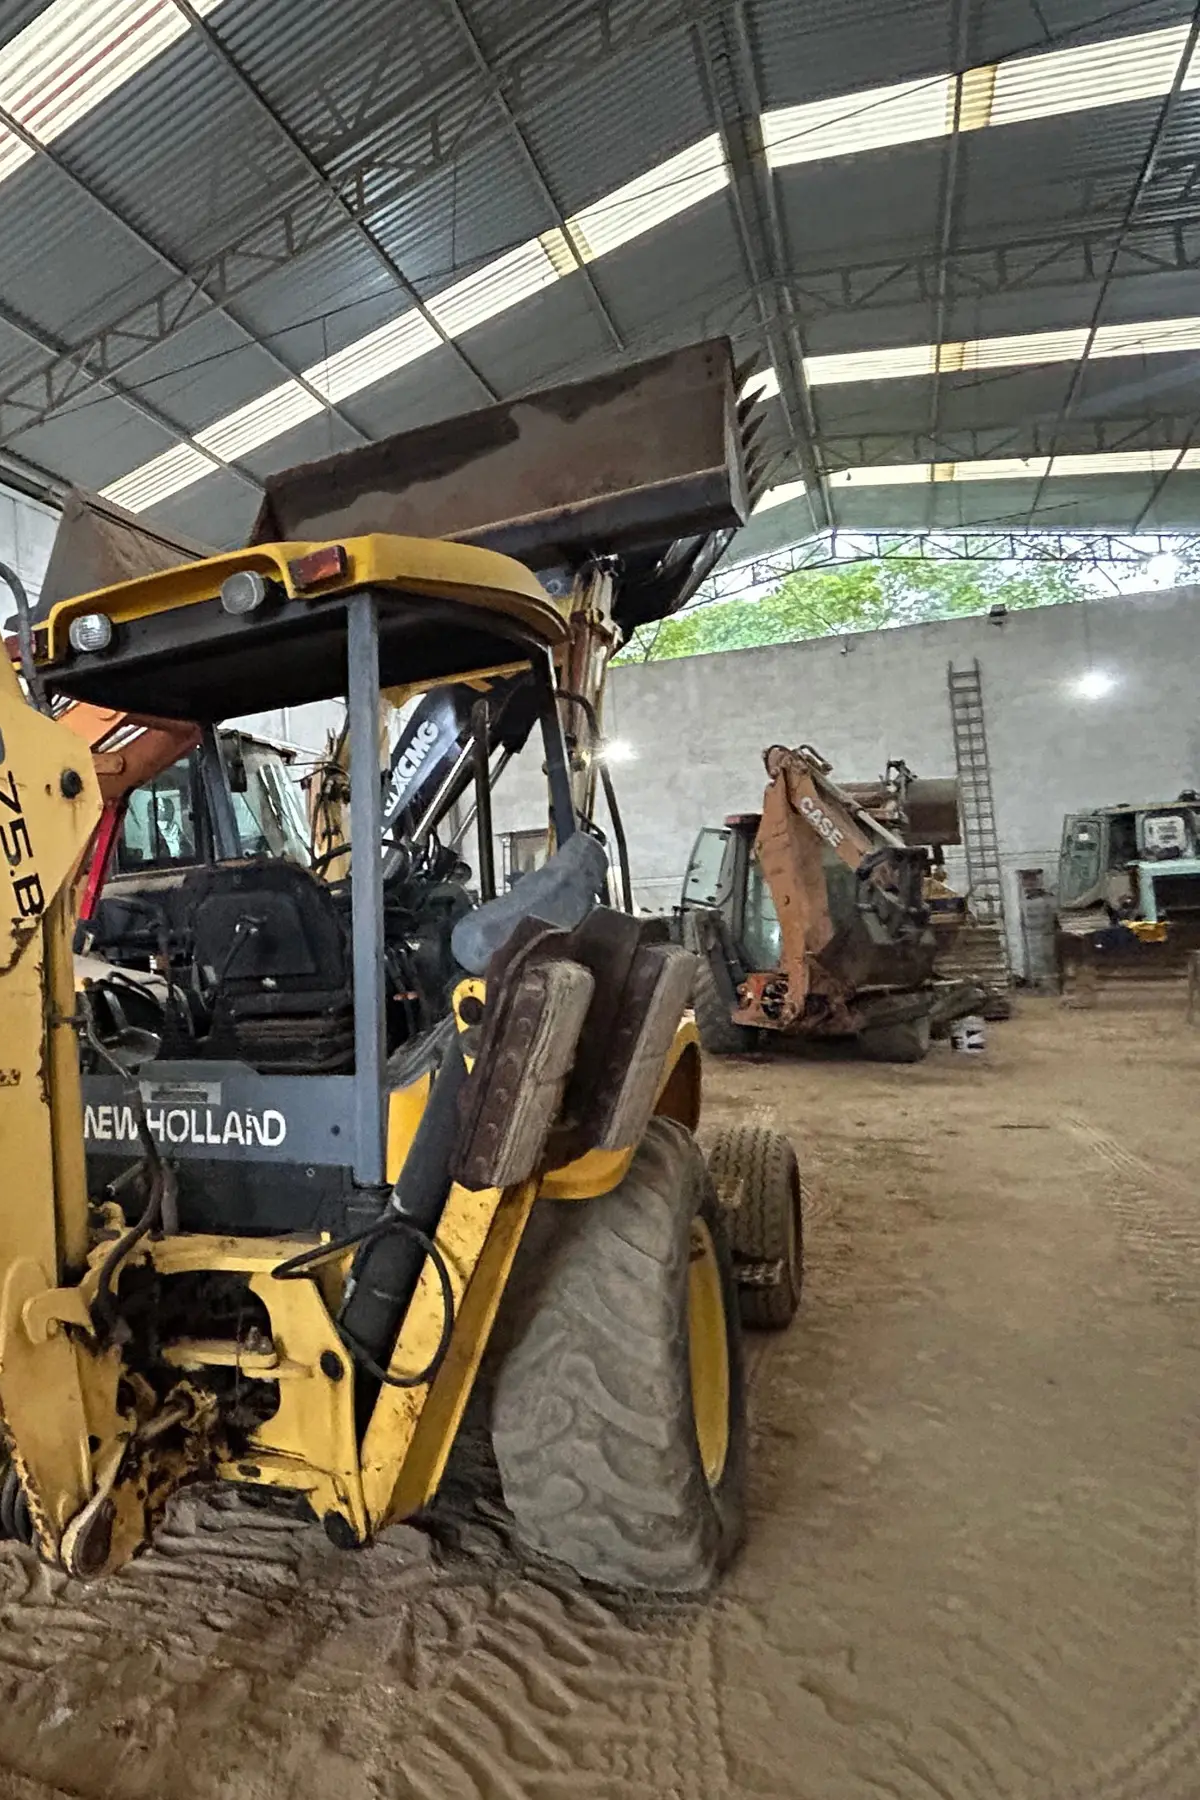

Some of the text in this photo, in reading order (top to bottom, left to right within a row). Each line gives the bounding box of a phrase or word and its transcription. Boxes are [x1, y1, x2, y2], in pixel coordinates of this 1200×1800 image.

[391, 720, 439, 793] XCMG
[800, 796, 844, 848] CASE
[84, 1105, 286, 1146] NEW HOLLAND
